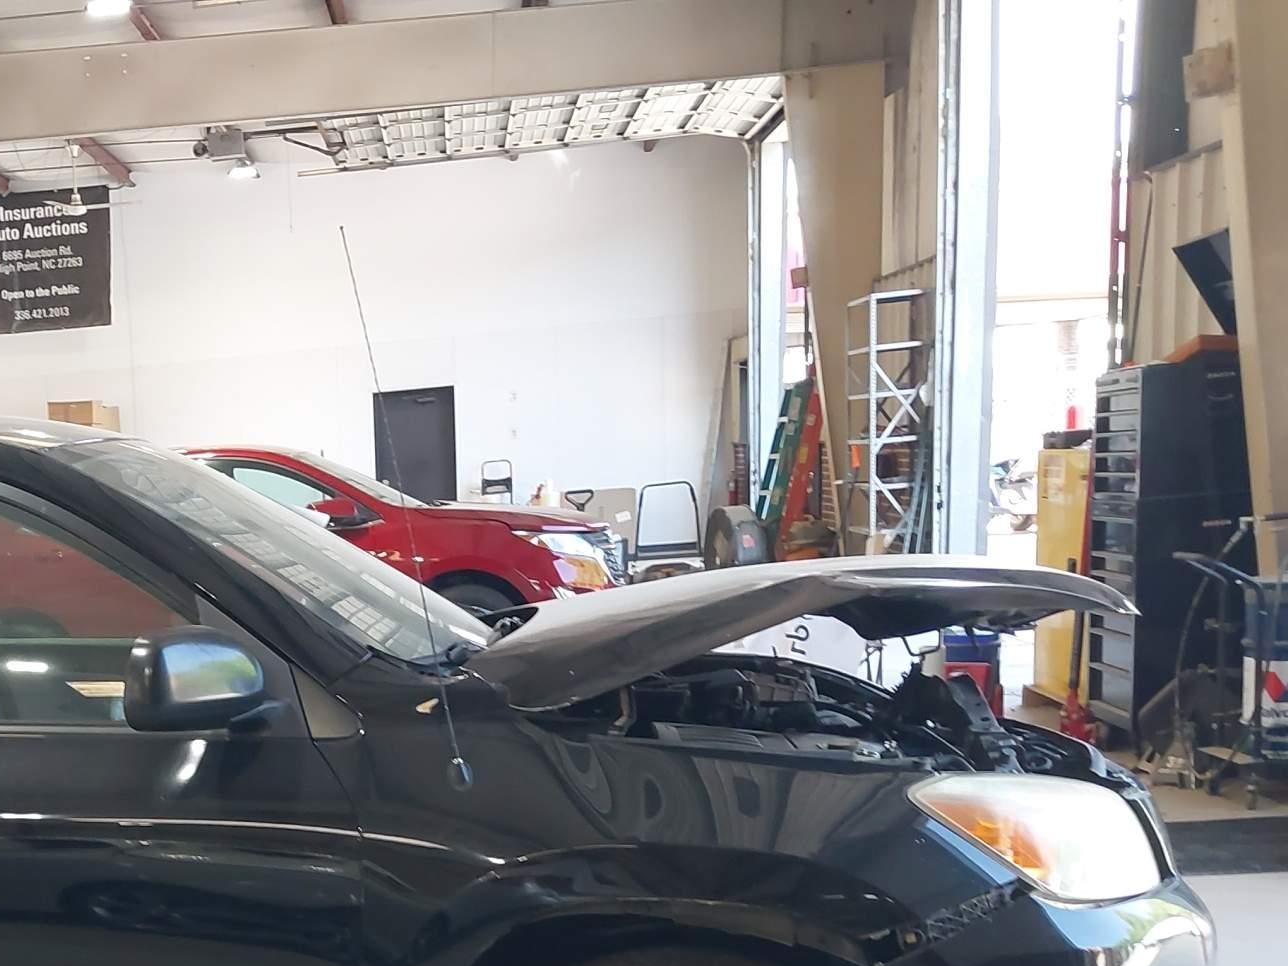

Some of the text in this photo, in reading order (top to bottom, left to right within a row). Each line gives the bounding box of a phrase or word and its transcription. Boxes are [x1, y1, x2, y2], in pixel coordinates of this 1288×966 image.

[0, 205, 70, 222] Insuranc
[22, 219, 89, 239] Auctions
[24, 247, 58, 259] Auction
[58, 245, 73, 256] Rd.
[16, 261, 41, 272] Point,
[42, 258, 56, 270] NC
[57, 256, 83, 268] 27263
[1, 283, 80, 302] Open to the Public
